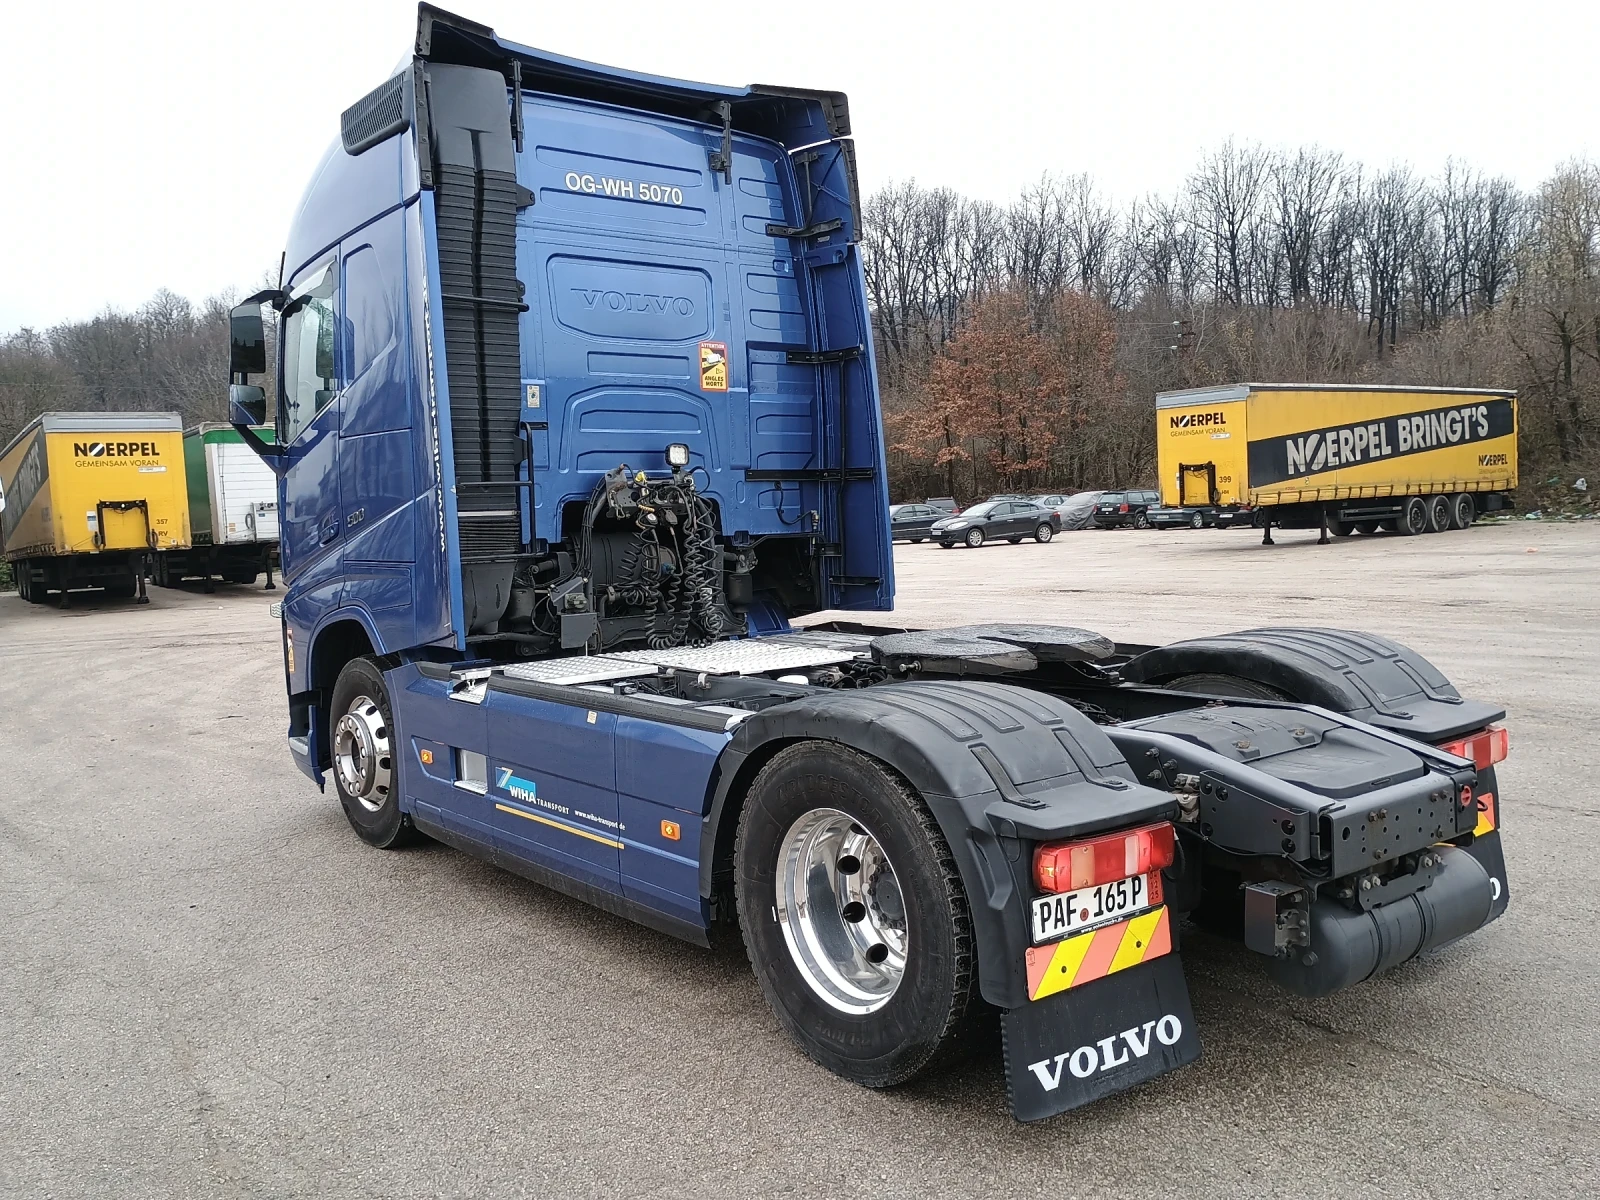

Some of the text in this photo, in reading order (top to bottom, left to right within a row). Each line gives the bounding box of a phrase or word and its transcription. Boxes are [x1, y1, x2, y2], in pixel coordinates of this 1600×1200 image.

[565, 172, 683, 205] OG-WH 5070
[570, 287, 696, 319] VOLVO
[1397, 405, 1489, 452] BRINGT'S
[75, 460, 128, 468] GEMEINSAM
[509, 785, 570, 815] WIHA TRANSPORT
[1039, 893, 1078, 934] PAF
[1028, 1014, 1183, 1093] VOLVO
